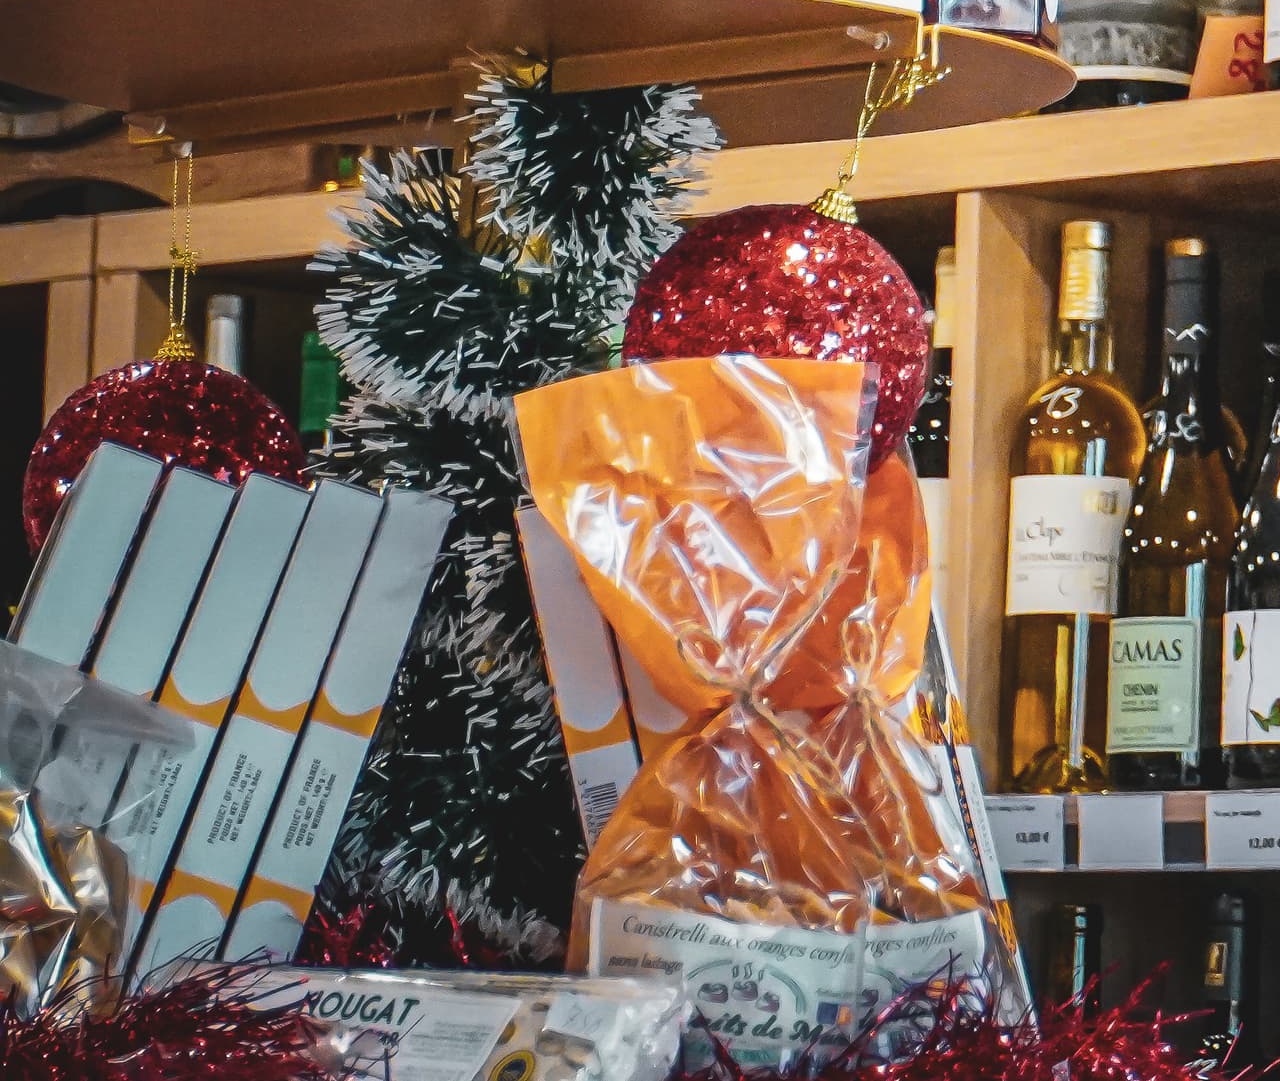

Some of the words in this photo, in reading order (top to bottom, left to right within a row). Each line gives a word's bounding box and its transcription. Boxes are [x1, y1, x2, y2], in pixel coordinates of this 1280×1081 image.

[1112, 637, 1184, 664] CAMAS
[230, 752, 248, 787] FRANCE
[303, 757, 322, 792] FRANCE
[622, 914, 706, 945] Canistrelli
[709, 932, 743, 948] aux
[747, 938, 806, 962] oranges
[300, 990, 421, 1027] NOUGAT
